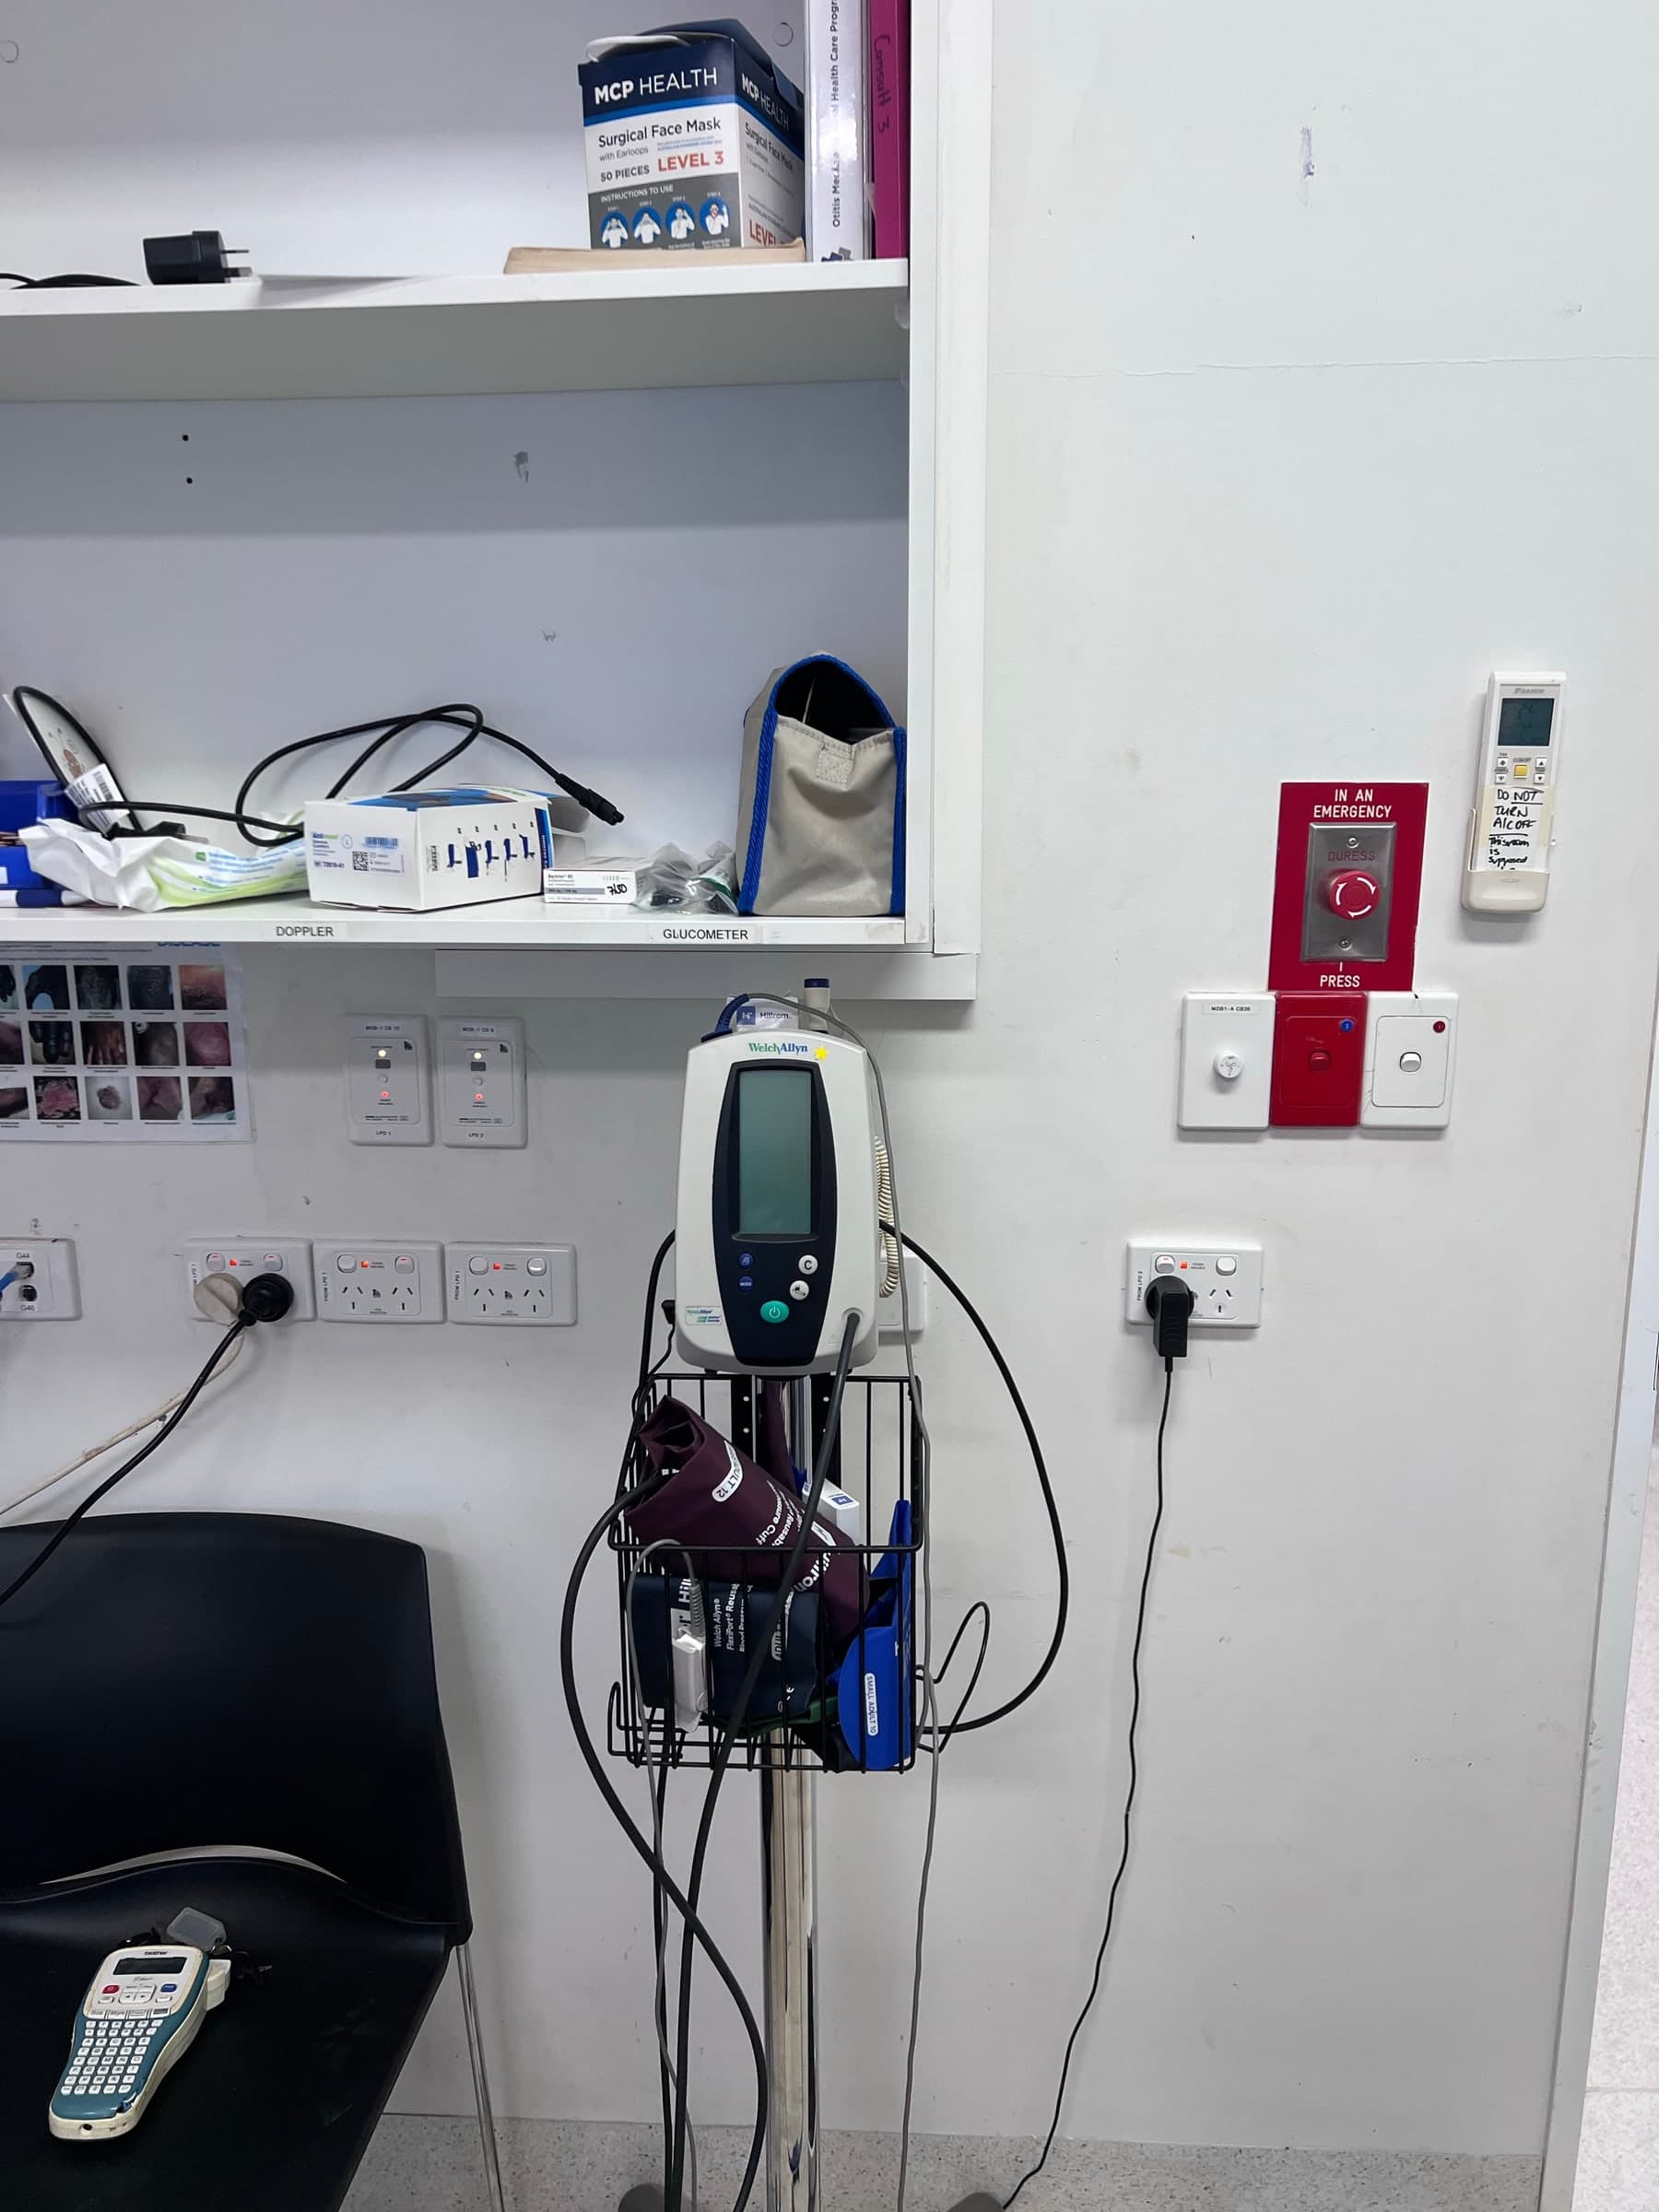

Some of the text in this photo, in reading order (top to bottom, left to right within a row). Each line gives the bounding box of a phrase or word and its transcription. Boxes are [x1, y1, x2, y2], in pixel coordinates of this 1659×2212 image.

[830, 36, 839, 61] Care
[594, 66, 718, 105] MCP HEALTH
[830, 65, 840, 101] Health
[741, 73, 790, 130] MCP HEALTH
[598, 125, 647, 147] Surgical
[651, 123, 682, 138] Face
[686, 117, 721, 133] Mask
[745, 122, 769, 149] Surgical
[599, 146, 649, 162] with Earloops
[657, 150, 724, 173] LEVEL 3
[600, 165, 650, 182] 50 PIECES
[600, 184, 674, 204] INSTRUCTIONS TO USE
[831, 198, 841, 228] Otitis
[1334, 788, 1373, 802] IN AN
[1497, 788, 1538, 802] DO NOT
[1313, 805, 1393, 818] EMERGENCY
[1494, 805, 1529, 817] TURN
[1327, 850, 1376, 862] DURESS
[276, 925, 335, 937] DOPPLER
[663, 927, 749, 940] GLUCOMETER
[1319, 974, 1361, 988] PRESS
[803, 1260, 813, 1270] C
[716, 1487, 729, 1499] 12
[755, 1524, 777, 1546] Cuff
[771, 1512, 794, 1547] Reusab
[712, 1625, 723, 1648] Welch
[868, 1701, 877, 1724] ADULT
[870, 1725, 877, 1734] 10
